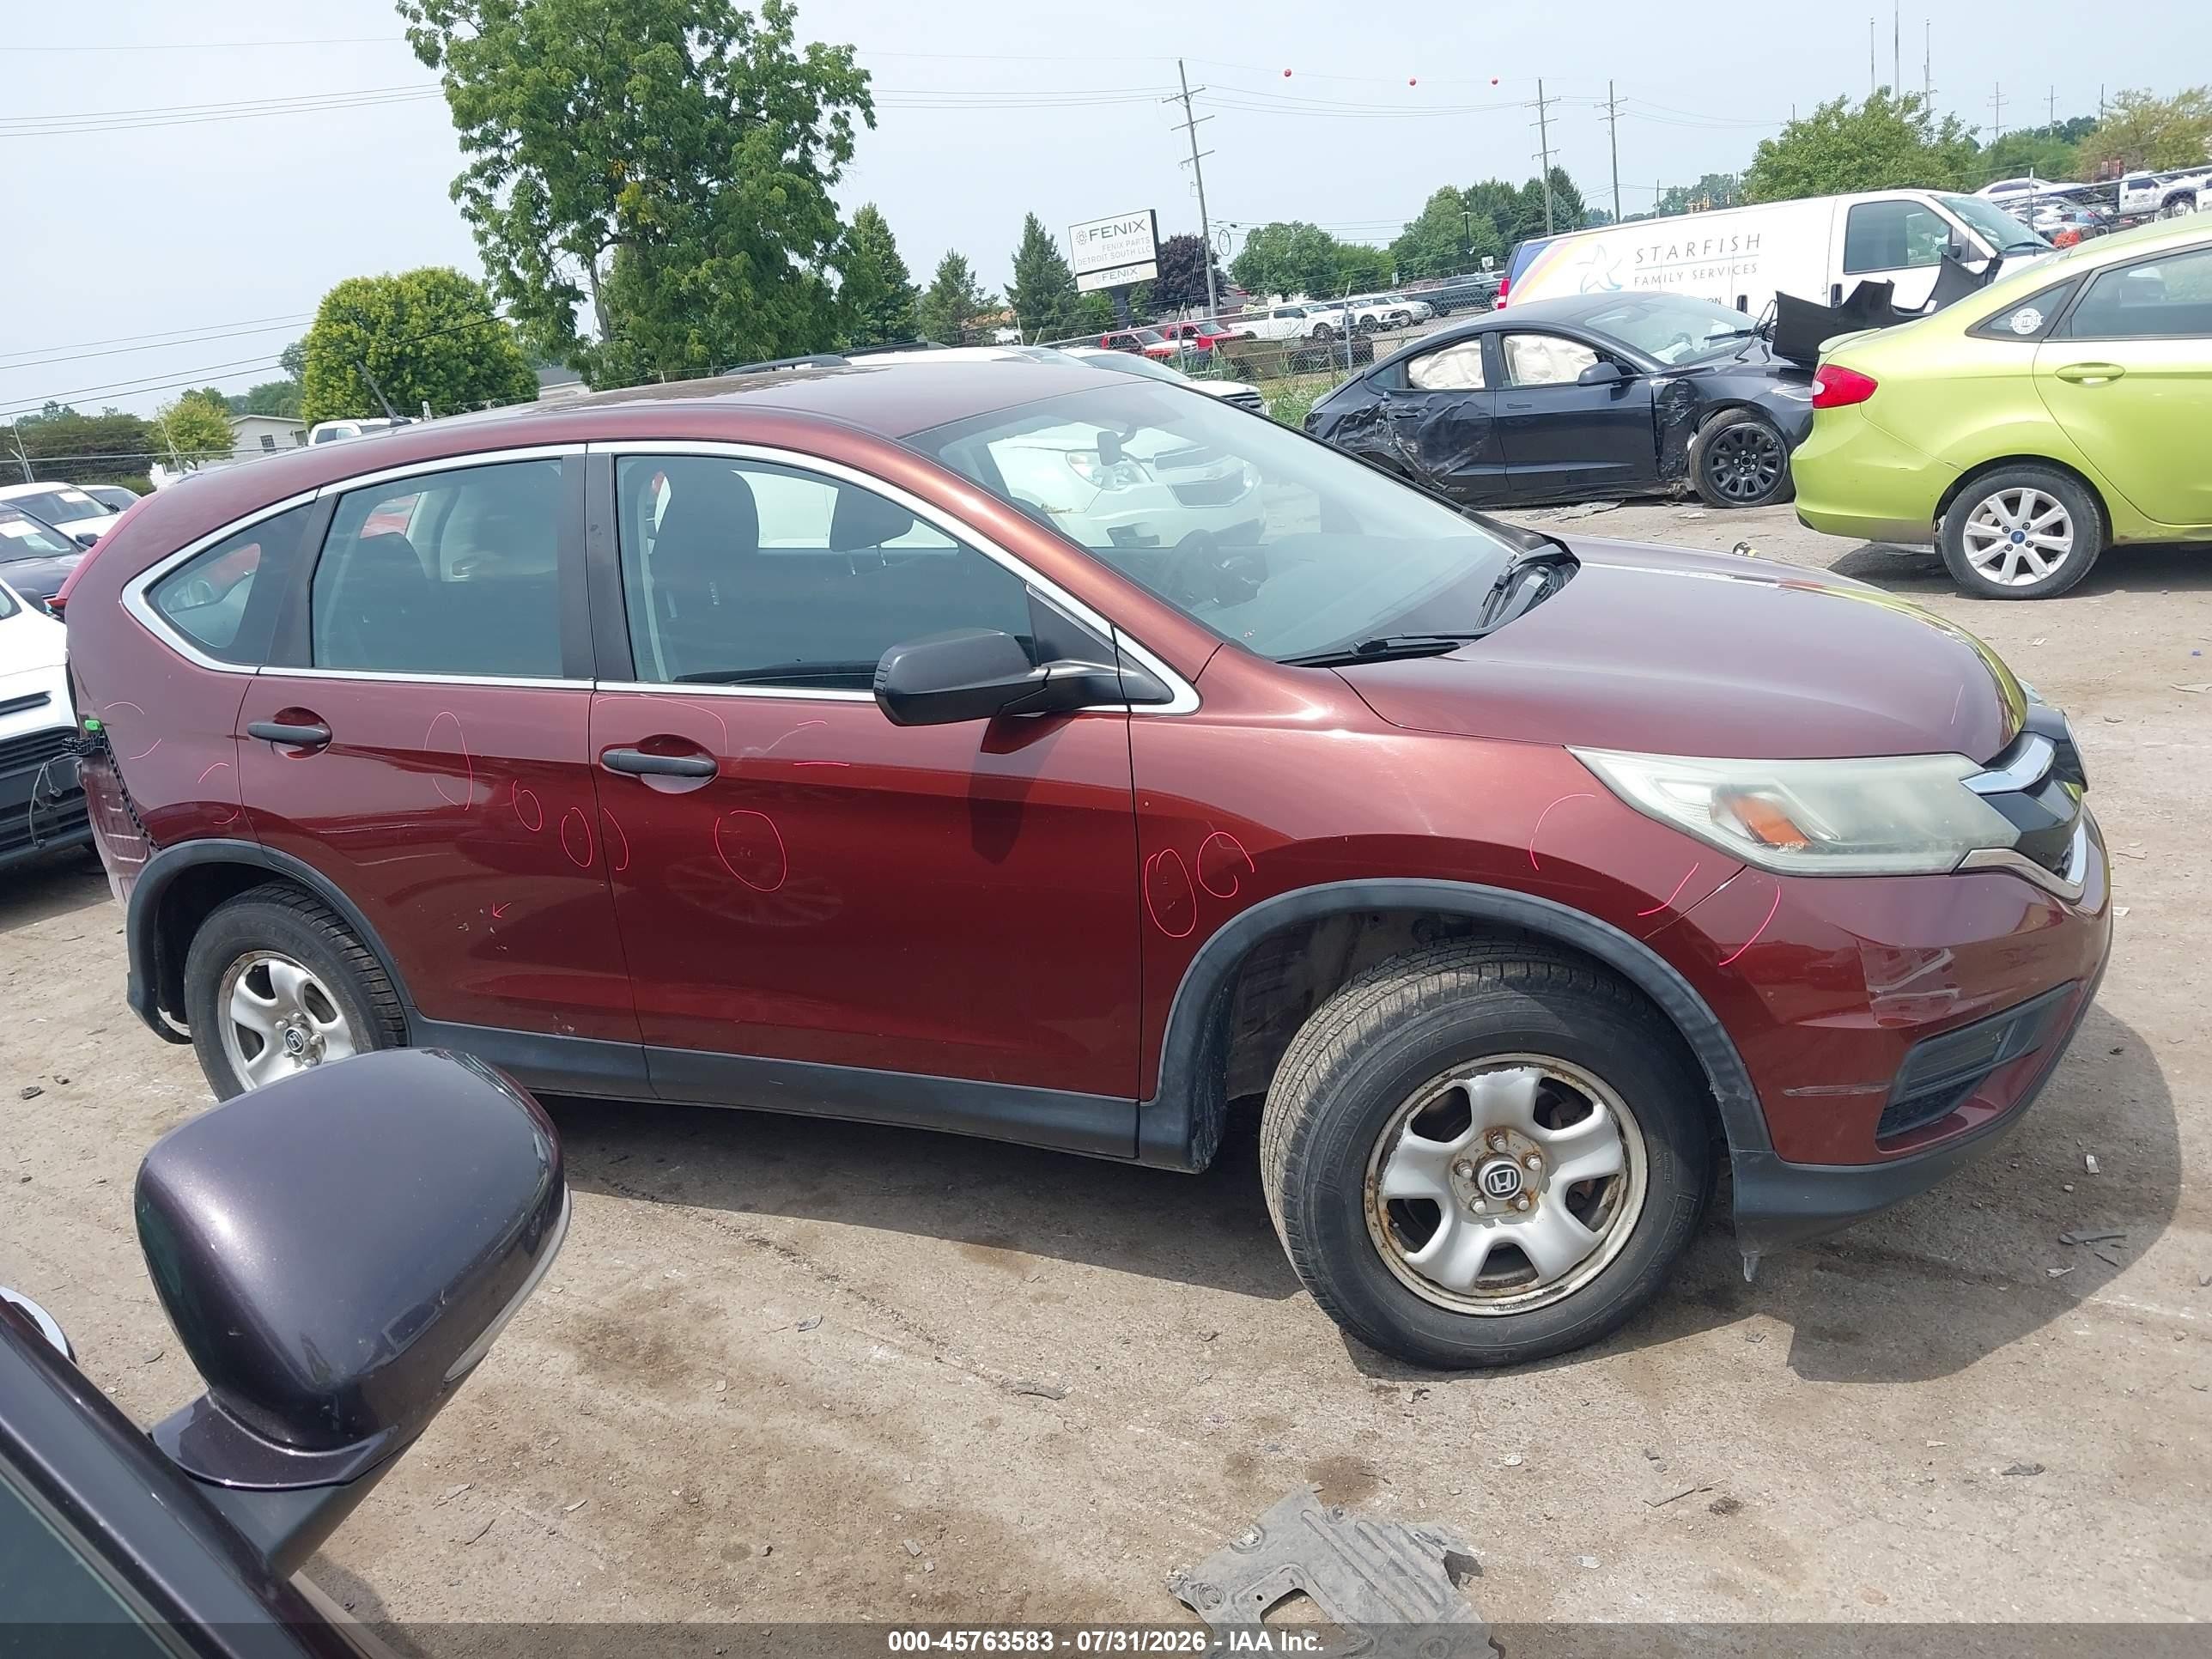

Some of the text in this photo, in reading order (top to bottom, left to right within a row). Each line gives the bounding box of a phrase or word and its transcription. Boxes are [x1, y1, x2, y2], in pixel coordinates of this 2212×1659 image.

[1089, 218, 1146, 242] FENIX
[1102, 236, 1151, 252] FENIX PARTS
[1635, 233, 1760, 264] STARFISH
[1077, 245, 1152, 266] DETROIT SOUTH LLC
[1102, 266, 1139, 282] FENIX
[1634, 262, 1758, 287] FAMILY SERVICES
